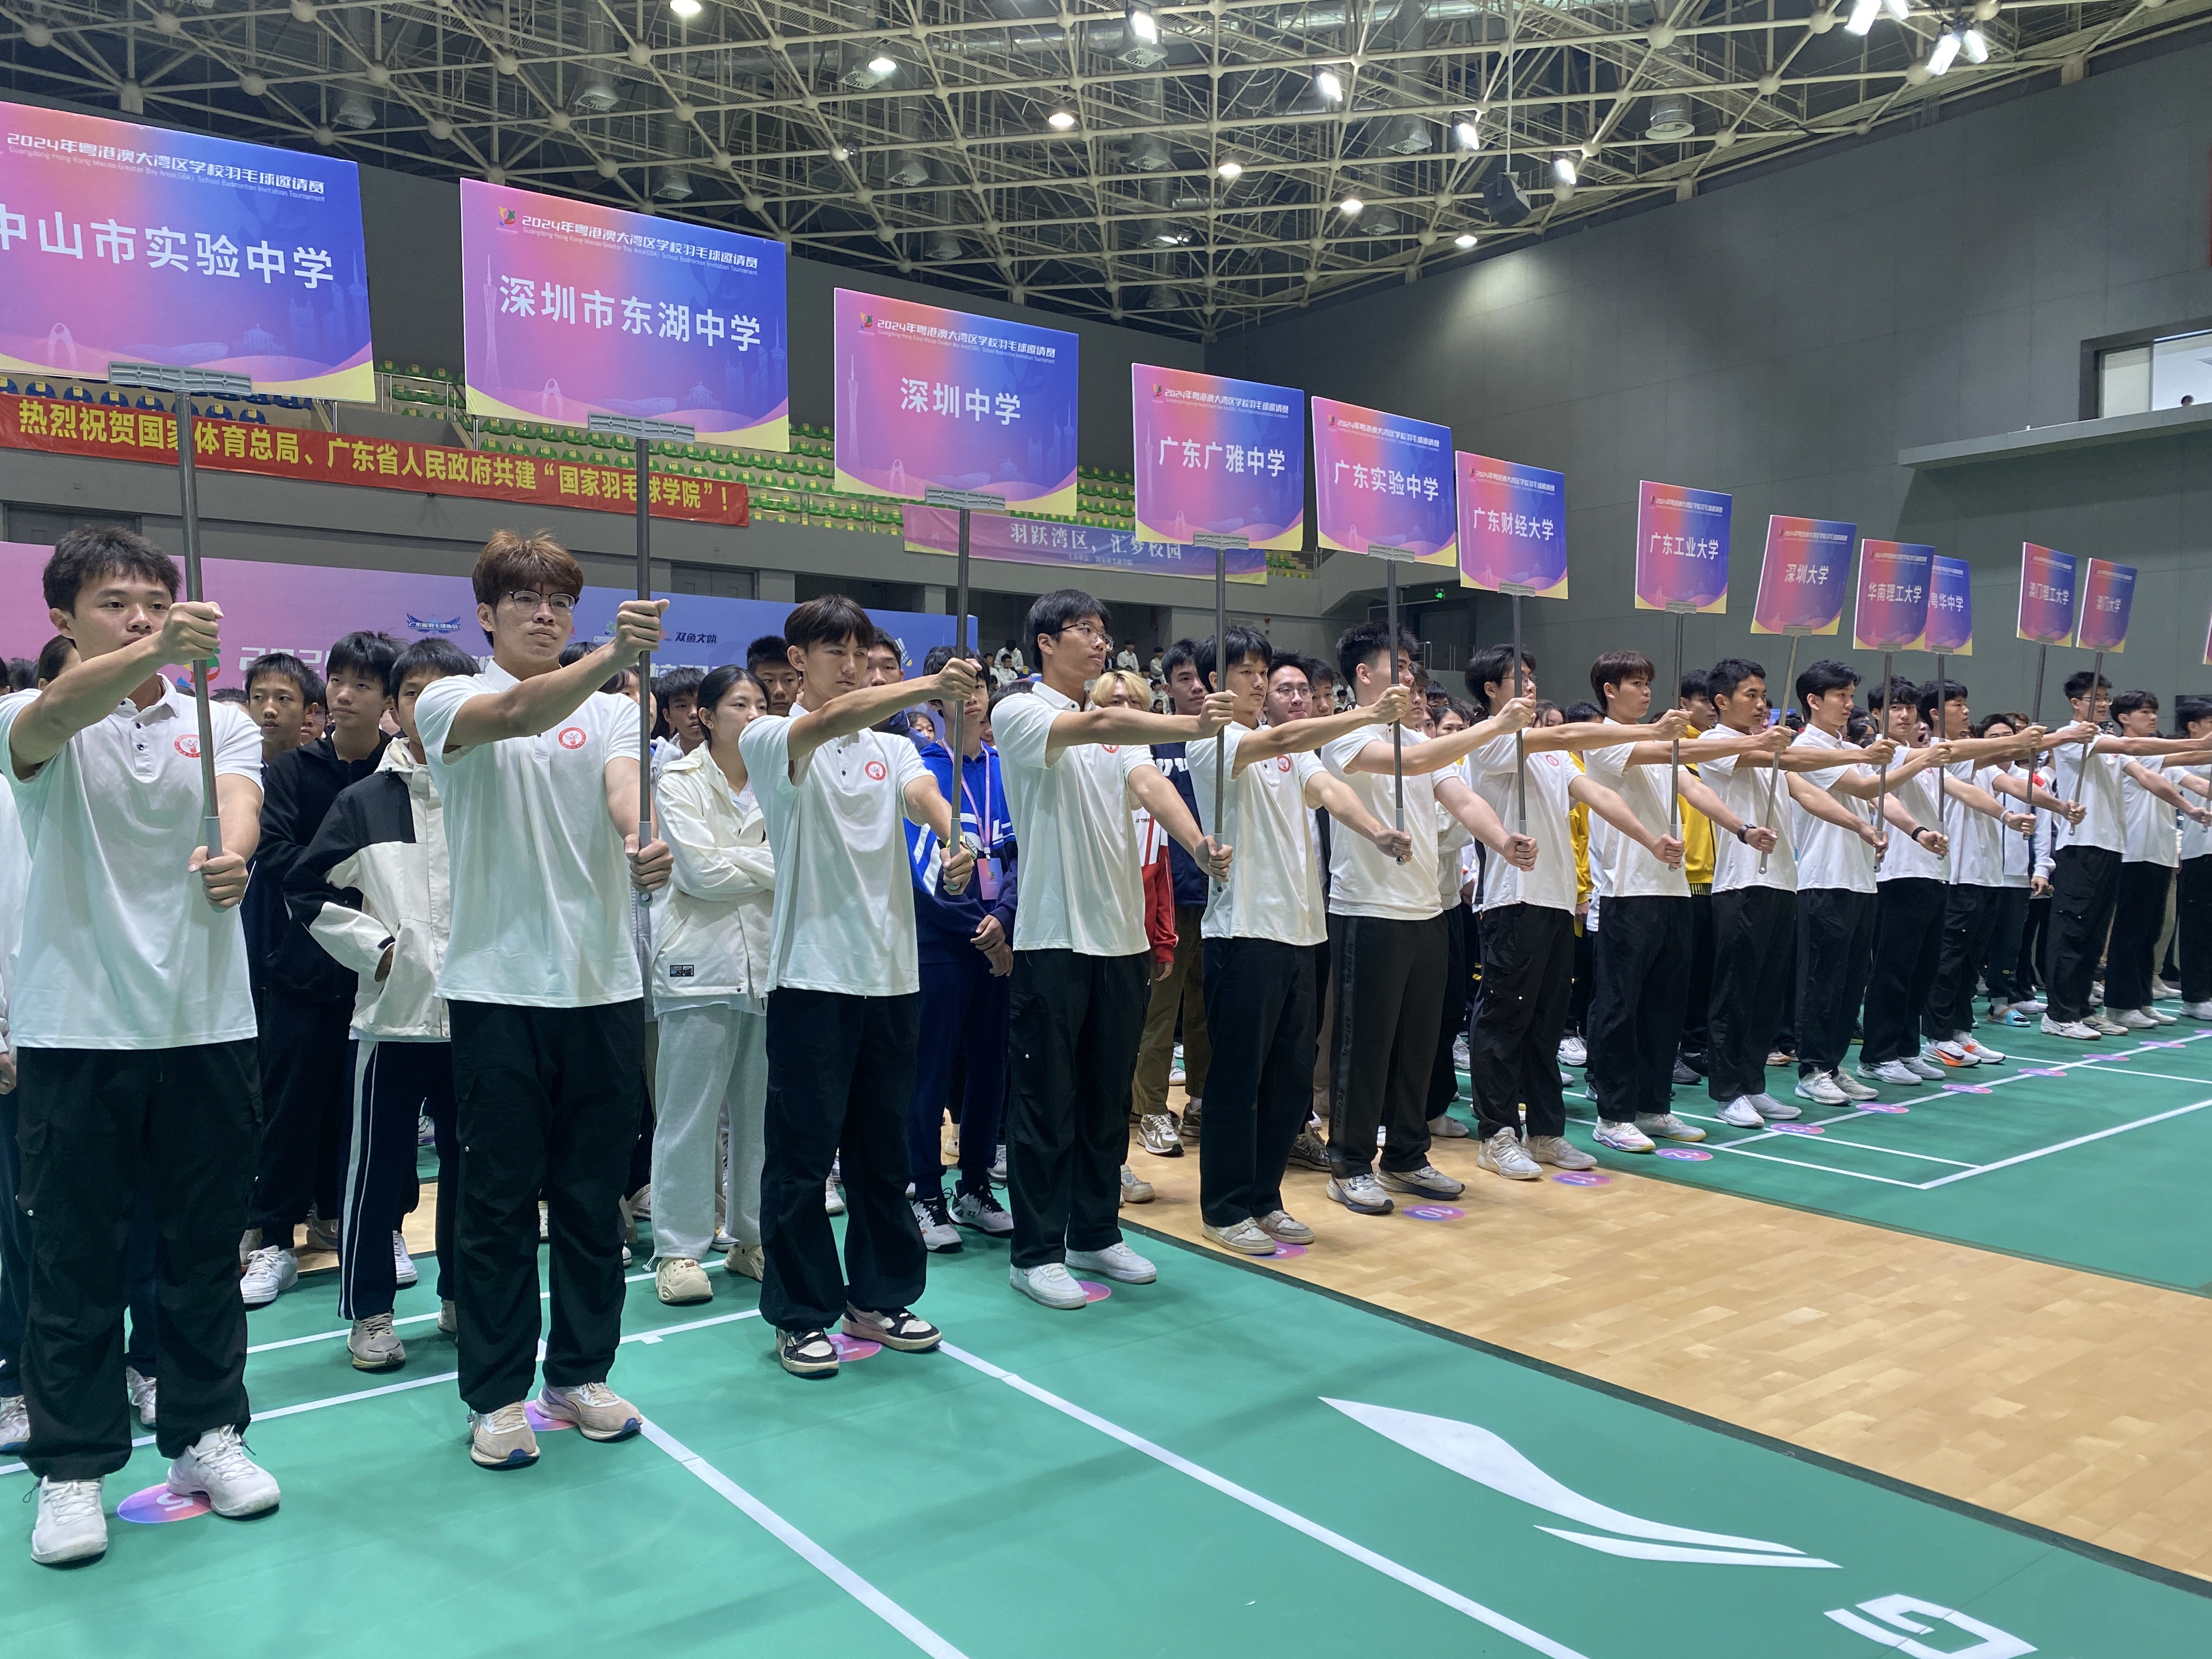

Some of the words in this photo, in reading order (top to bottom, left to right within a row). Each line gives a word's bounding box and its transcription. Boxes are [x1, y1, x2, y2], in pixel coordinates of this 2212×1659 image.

[7, 133, 325, 194] 2024年粤港澳大湾区学校羽毛球邀请赛
[118, 162, 144, 173] Greater
[145, 167, 157, 176] Bay
[198, 176, 220, 185] School
[222, 179, 257, 191] Badminton
[258, 186, 287, 196] Invitation
[289, 190, 325, 202] Tournament
[0, 203, 334, 290] 中山市实验中学
[522, 215, 758, 269] 2024年粤港澳大湾区学校羽毛球邀请赛
[603, 241, 622, 251] Greater
[662, 253, 679, 261] School
[680, 256, 706, 266] Badminton
[707, 261, 730, 270] Invitation
[730, 265, 758, 275] Tournament
[499, 274, 761, 352] 深圳市东湖中学
[877, 319, 1056, 358] 2024年粤港澳大湾区学校羽毛球邀请赛
[900, 377, 1021, 426] 深圳中学
[1164, 388, 1289, 414] 2024年粤港澳大湾区学校羽毛球邀请赛
[1159, 436, 1285, 478] 广东广雅中学
[1334, 459, 1439, 502] 广东实验中学
[1473, 506, 1554, 541] 广东财经大学
[1010, 523, 1182, 560] 羽跃湾区，汇梦校园
[1649, 531, 1719, 560] 广东工业大学
[1784, 563, 1830, 585] 深圳大学
[1867, 582, 1922, 603] 华南理工大学
[1928, 591, 1964, 612] 粤华中学
[675, 632, 718, 644] 双鱼文体
[1664, 1150, 1700, 1159] 12
[1563, 1175, 1597, 1184] 11
[1415, 1207, 1453, 1218] 10
[156, 1492, 194, 1512] 5
